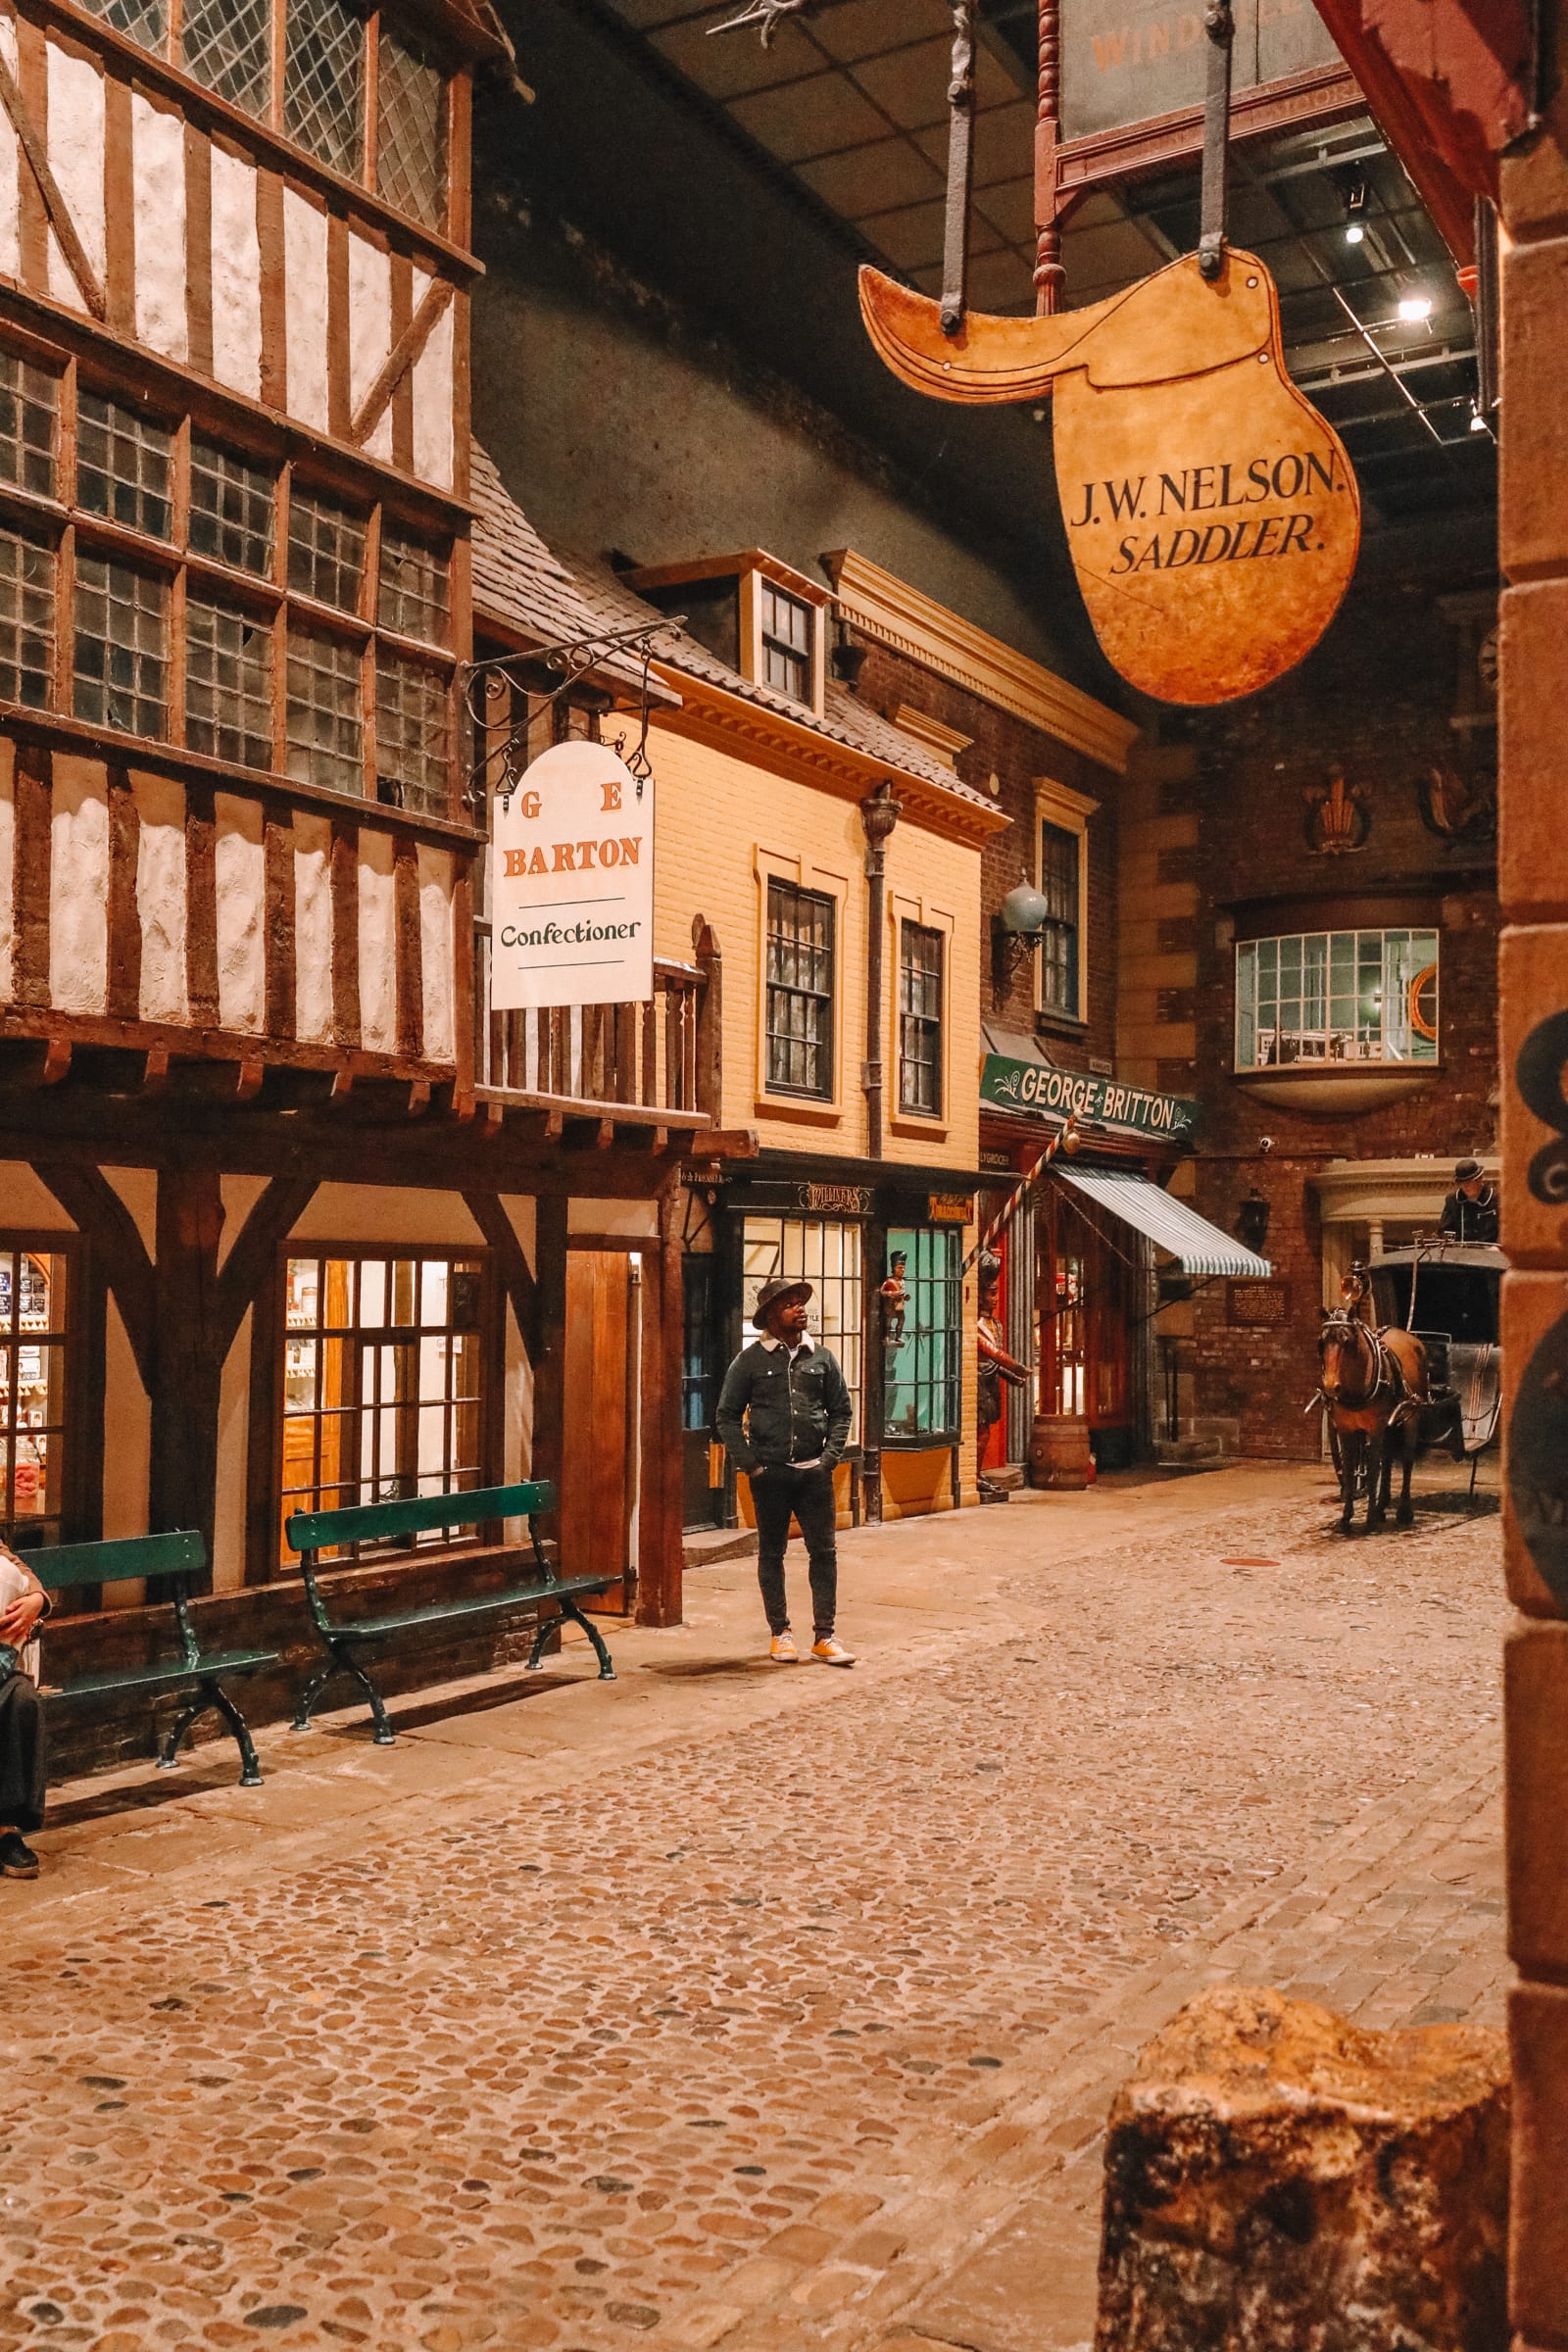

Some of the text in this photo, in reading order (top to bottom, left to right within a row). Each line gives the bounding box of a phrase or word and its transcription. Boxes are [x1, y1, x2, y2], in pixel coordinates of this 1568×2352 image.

[1070, 449, 1346, 527] J.W. NELSON.
[1109, 514, 1326, 575] SADDLER.
[520, 781, 622, 819] G E
[503, 836, 643, 878] BARTON
[500, 919, 642, 949] Confectioner
[1020, 1067, 1176, 1131] GEORGE BRITTON
